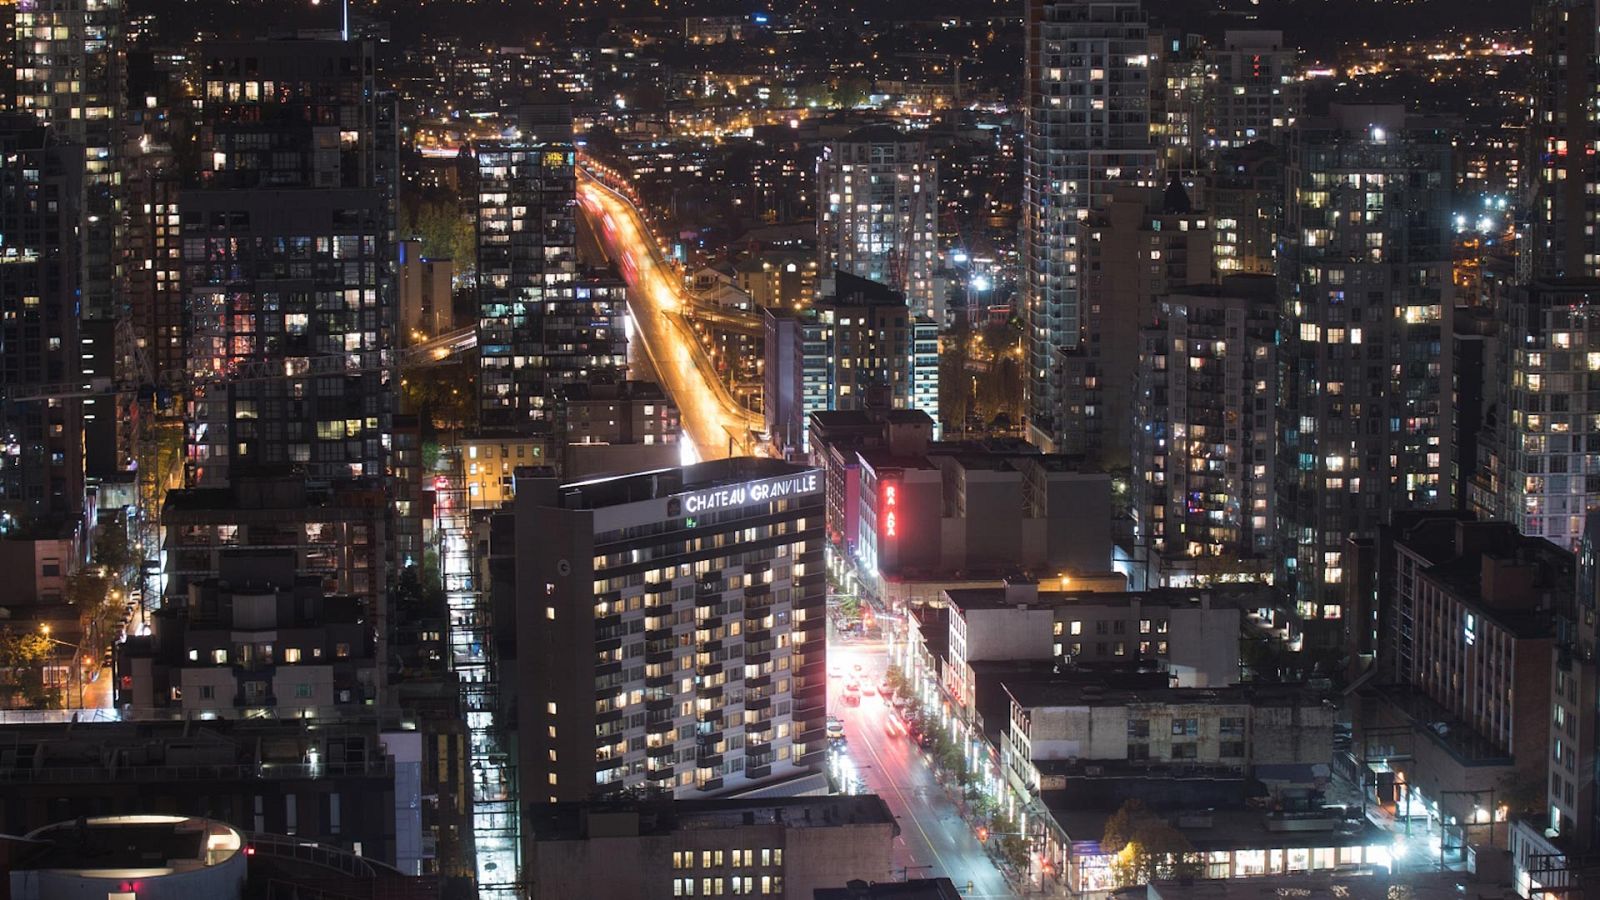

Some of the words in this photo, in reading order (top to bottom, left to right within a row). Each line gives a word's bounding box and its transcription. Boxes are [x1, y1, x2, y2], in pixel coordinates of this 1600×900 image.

[686, 488, 745, 513] CHATEAU
[750, 475, 817, 501] GRANVILLE
[886, 486, 896, 537] RAADA
